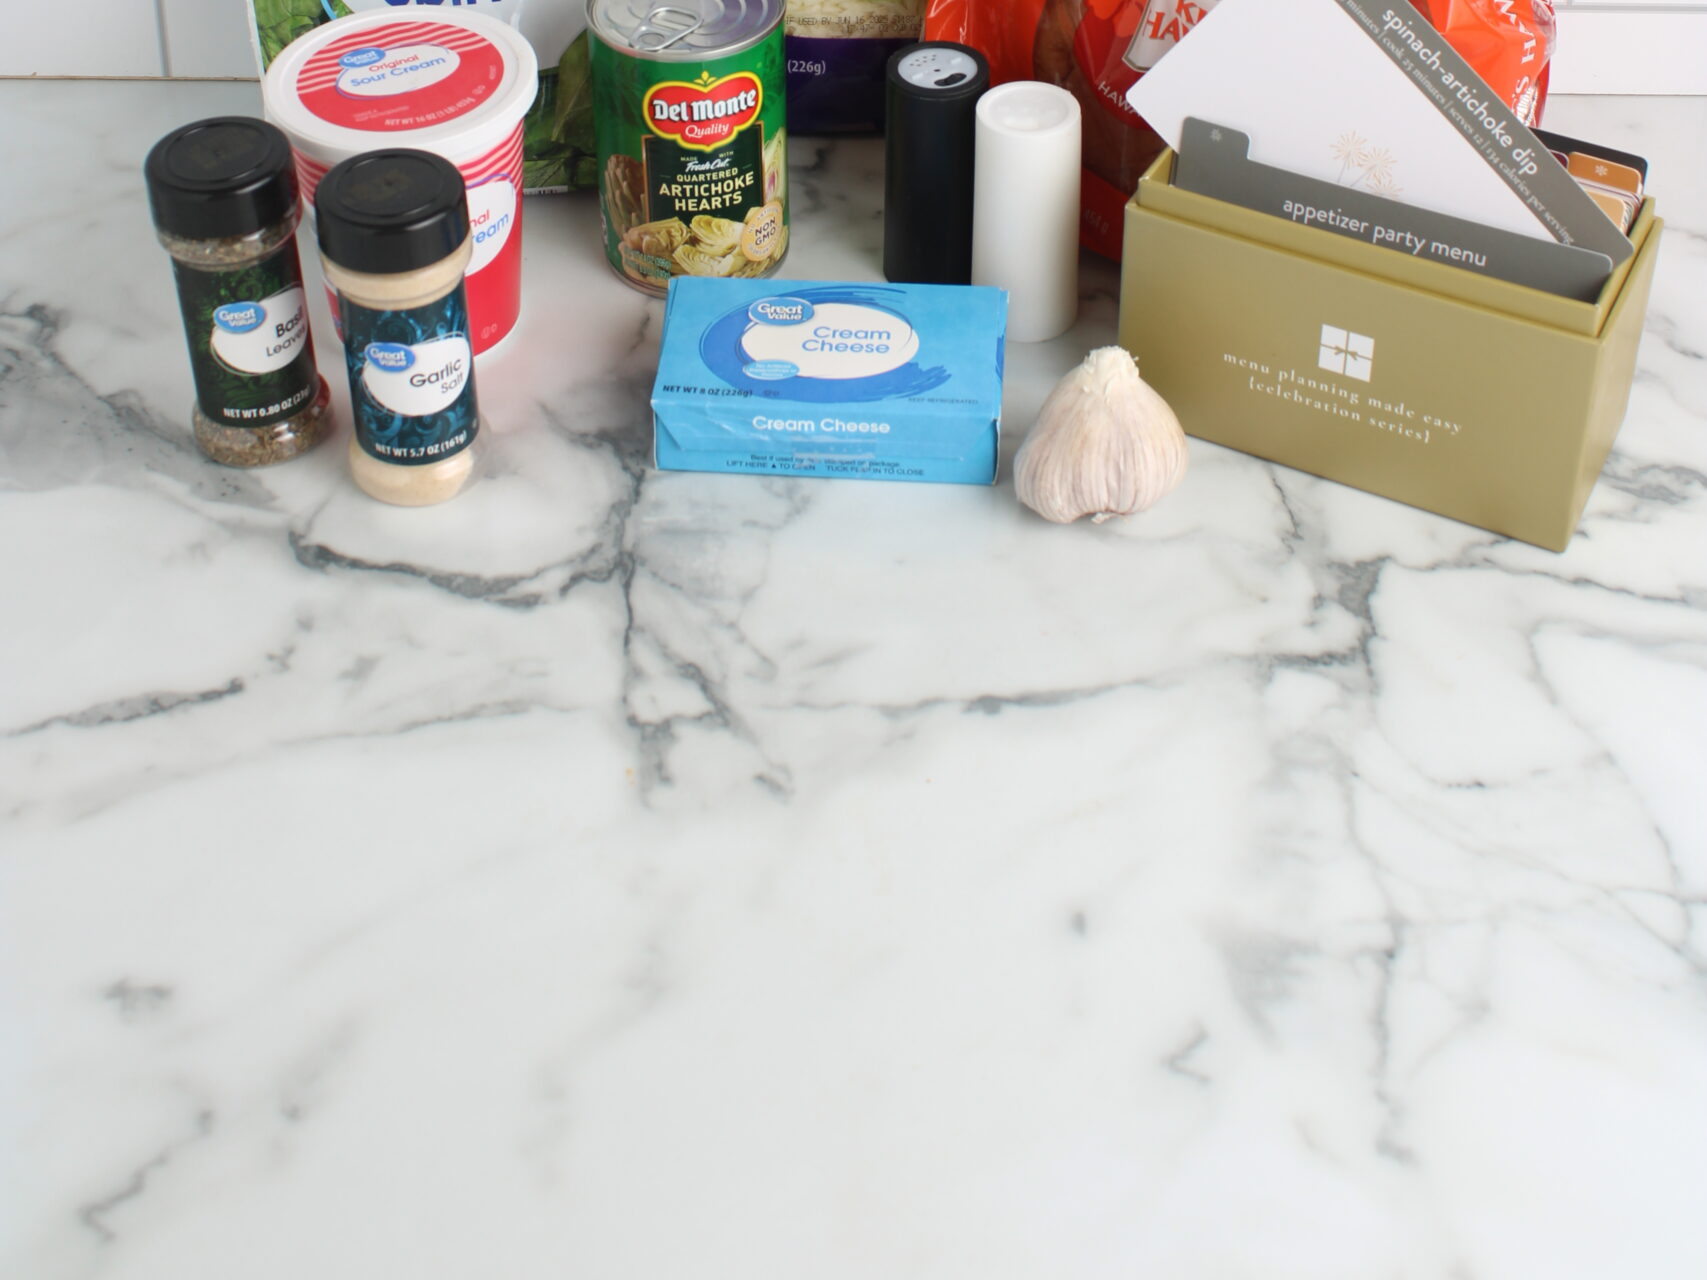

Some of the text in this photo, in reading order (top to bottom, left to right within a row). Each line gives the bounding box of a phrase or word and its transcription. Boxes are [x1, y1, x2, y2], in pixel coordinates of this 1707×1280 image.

[344, 50, 377, 64] Great
[369, 54, 420, 73] Original
[351, 56, 446, 87] Sour Cream
[787, 60, 826, 76] (226g)
[1382, 9, 1538, 175] spinach-artichoke dip
[653, 89, 757, 122] Del Monte
[685, 123, 730, 139] Quality
[1382, 37, 1404, 59] cook
[1412, 68, 1445, 104] minutes
[1449, 108, 1474, 134] serves
[1473, 133, 1483, 145] 12
[1498, 161, 1531, 197] calories
[1527, 194, 1545, 212] per
[1544, 210, 1575, 245] serving
[659, 171, 754, 197] ARTICHOKE
[676, 167, 738, 182] QUARTERED
[674, 191, 743, 212] HEARTS
[755, 216, 776, 237] NON
[755, 226, 776, 246] GMO
[1282, 199, 1488, 267] appetizer party menu
[219, 308, 256, 321] Great
[757, 303, 803, 317] Great
[766, 312, 802, 321] Value
[813, 326, 891, 341] Cream
[370, 348, 406, 361] Great
[802, 339, 890, 354] Cheese
[410, 359, 462, 388] Garlic
[441, 372, 464, 394] Salt
[662, 385, 681, 393] NET
[683, 385, 698, 394] WT
[707, 388, 720, 397] OZ
[1223, 352, 1463, 435] menu planning made easy
[223, 408, 240, 418] NET
[242, 408, 258, 419] WT
[259, 404, 280, 417] 0.80
[281, 398, 292, 410] OZ
[752, 415, 891, 434] Cream Cheese
[375, 443, 391, 454] NET
[393, 447, 408, 457] WT
[410, 447, 425, 457] 5.7
[427, 444, 439, 455] OZ
[745, 461, 768, 469] HERE
[896, 468, 924, 476] CLOSE
